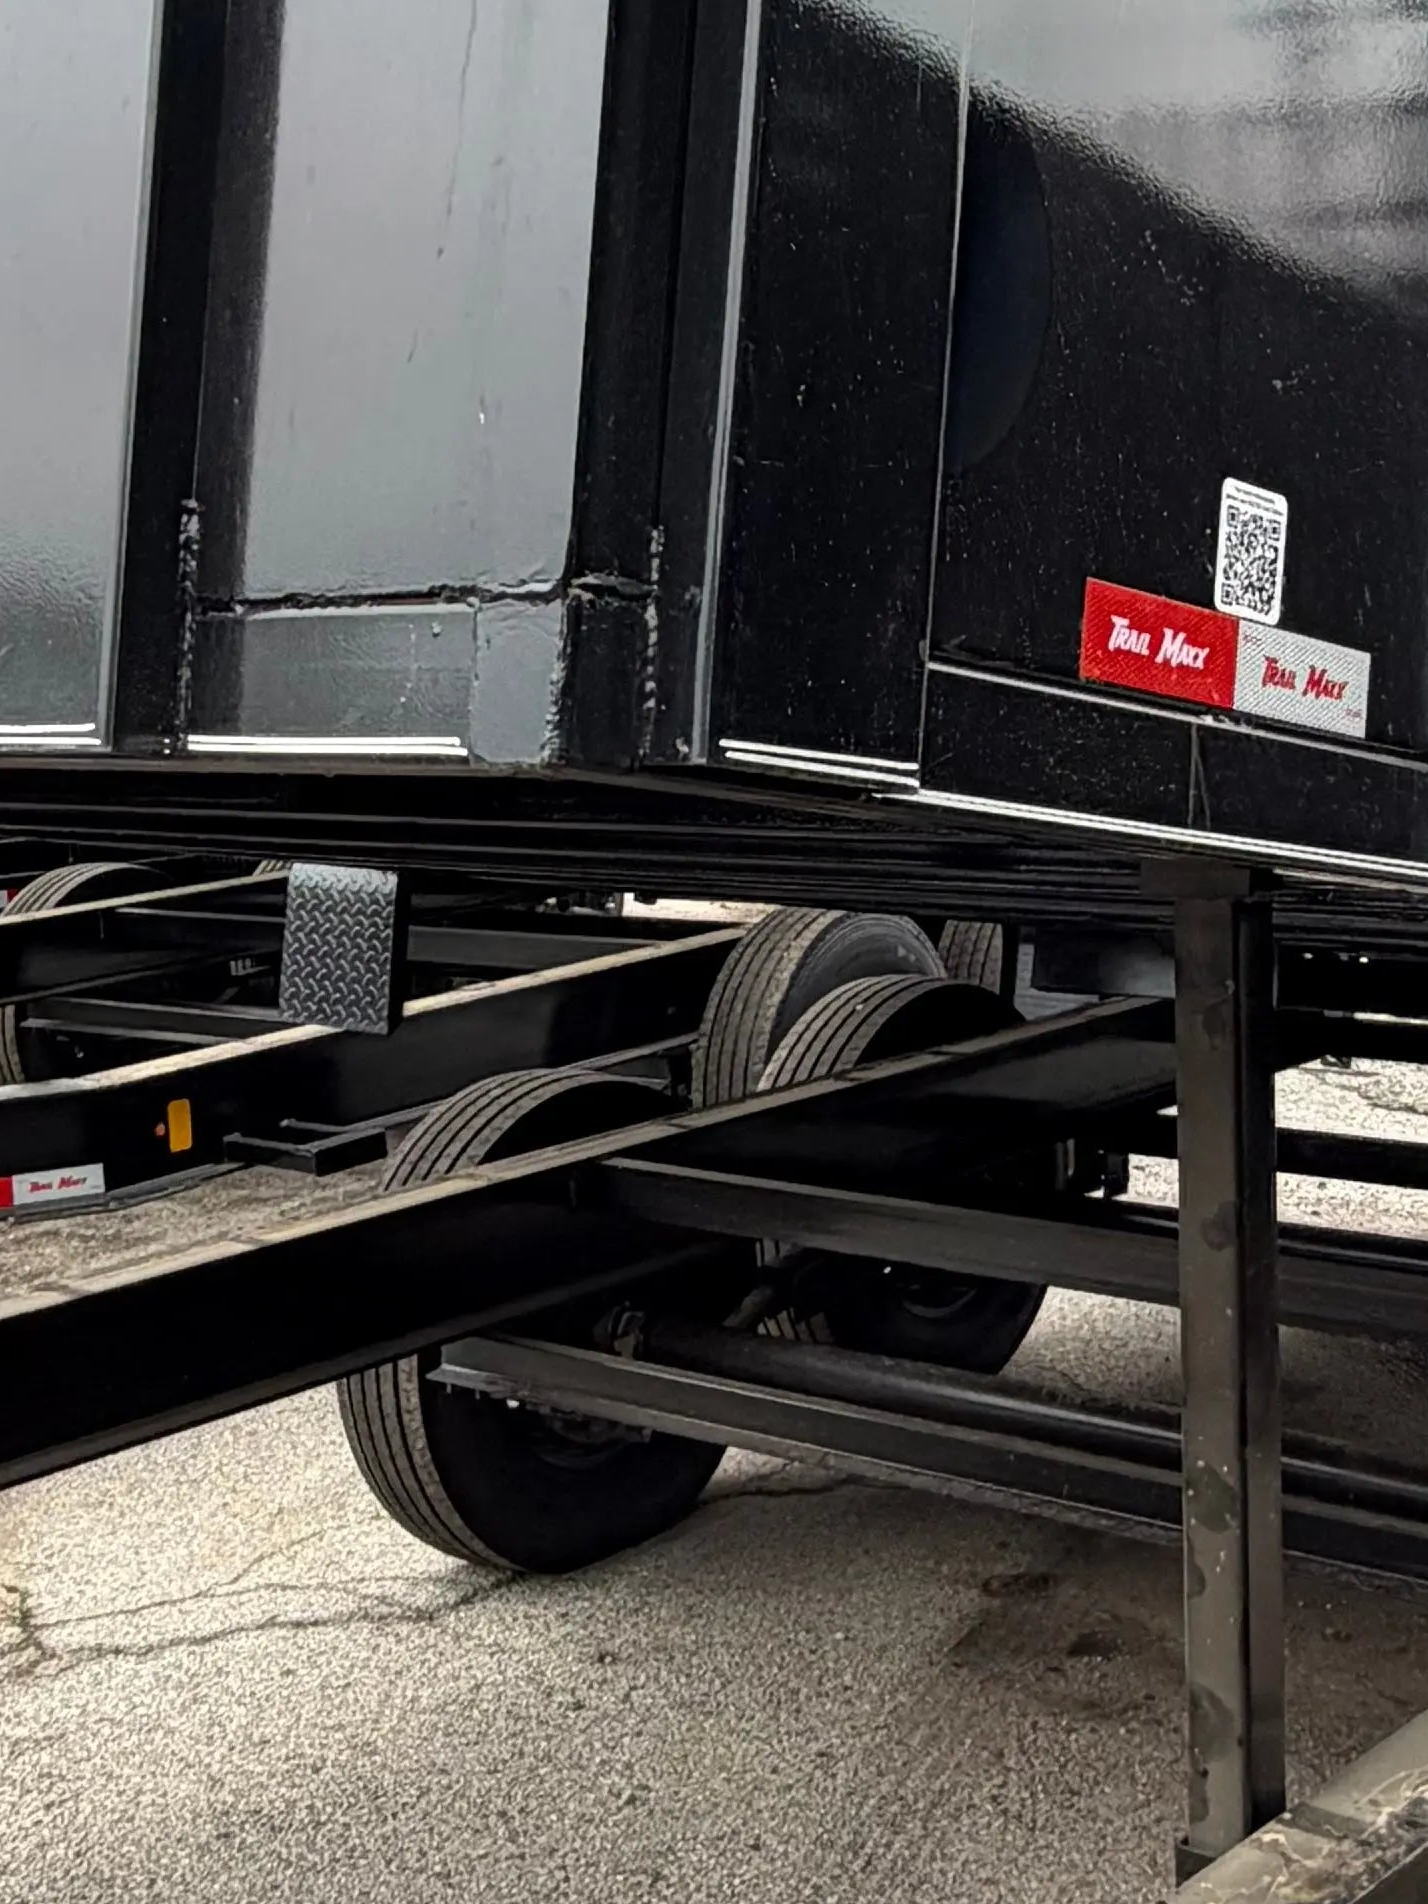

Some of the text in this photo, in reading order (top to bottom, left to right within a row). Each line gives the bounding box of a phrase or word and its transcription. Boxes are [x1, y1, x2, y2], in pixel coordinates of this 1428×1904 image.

[1107, 614, 1210, 670] TRAIL MAXX
[1262, 654, 1349, 701] TRAIL MAXX
